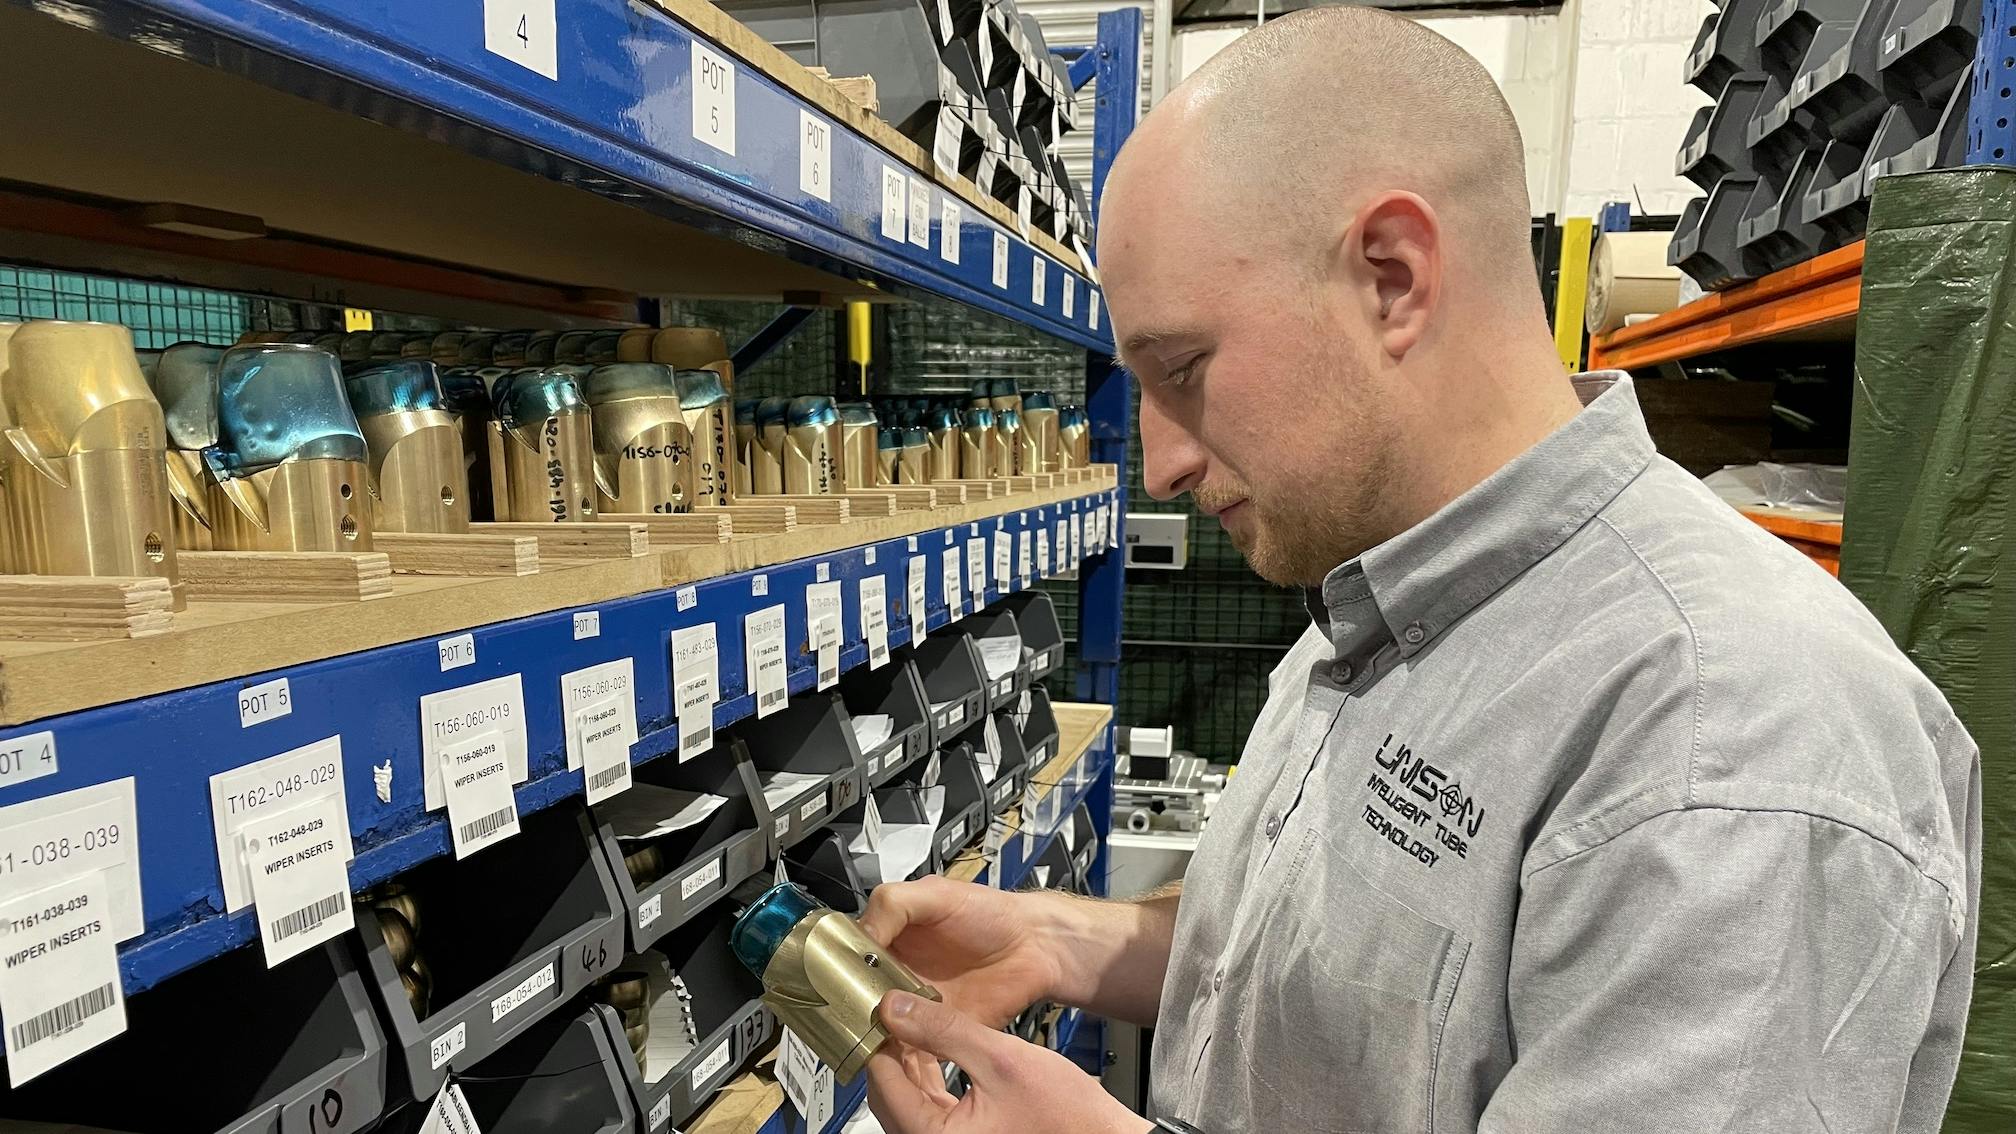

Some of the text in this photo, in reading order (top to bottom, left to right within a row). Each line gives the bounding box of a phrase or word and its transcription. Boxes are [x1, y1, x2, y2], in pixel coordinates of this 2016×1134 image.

[517, 13, 528, 48] 4
[702, 56, 726, 95] POT
[711, 106, 718, 134] 5
[807, 121, 825, 151] POT
[813, 162, 819, 185] 6
[887, 174, 900, 200] POT
[677, 594, 688, 607] POT
[574, 617, 598, 633] POT 7
[441, 642, 473, 664] POT 6
[572, 675, 627, 701] T156-060-029
[240, 688, 288, 718] POT 5
[434, 703, 511, 738] T156-060-019
[586, 723, 622, 744] WIPER INSERTS
[40, 744, 52, 763] 4
[456, 744, 496, 766] T156-060-019
[227, 763, 336, 815] T162-048-029
[454, 762, 504, 789] WIPER INSERTS
[1375, 733, 1485, 838] UNISON
[1367, 772, 1468, 859] INTELLIGENT TUBE
[268, 818, 324, 847] T162-048-029
[1361, 804, 1440, 868] TECHNOLOGY
[265, 840, 334, 875] WIPER INSERTS
[11, 894, 89, 934] T161-038-039
[640, 905, 653, 922] BIN
[5, 919, 102, 969] WIPER INSERTS
[582, 939, 607, 972] 46
[433, 1030, 464, 1063] BIN 2
[309, 1089, 343, 1134] 10
[649, 1107, 662, 1126] BIN
[818, 1102, 824, 1122] 6
